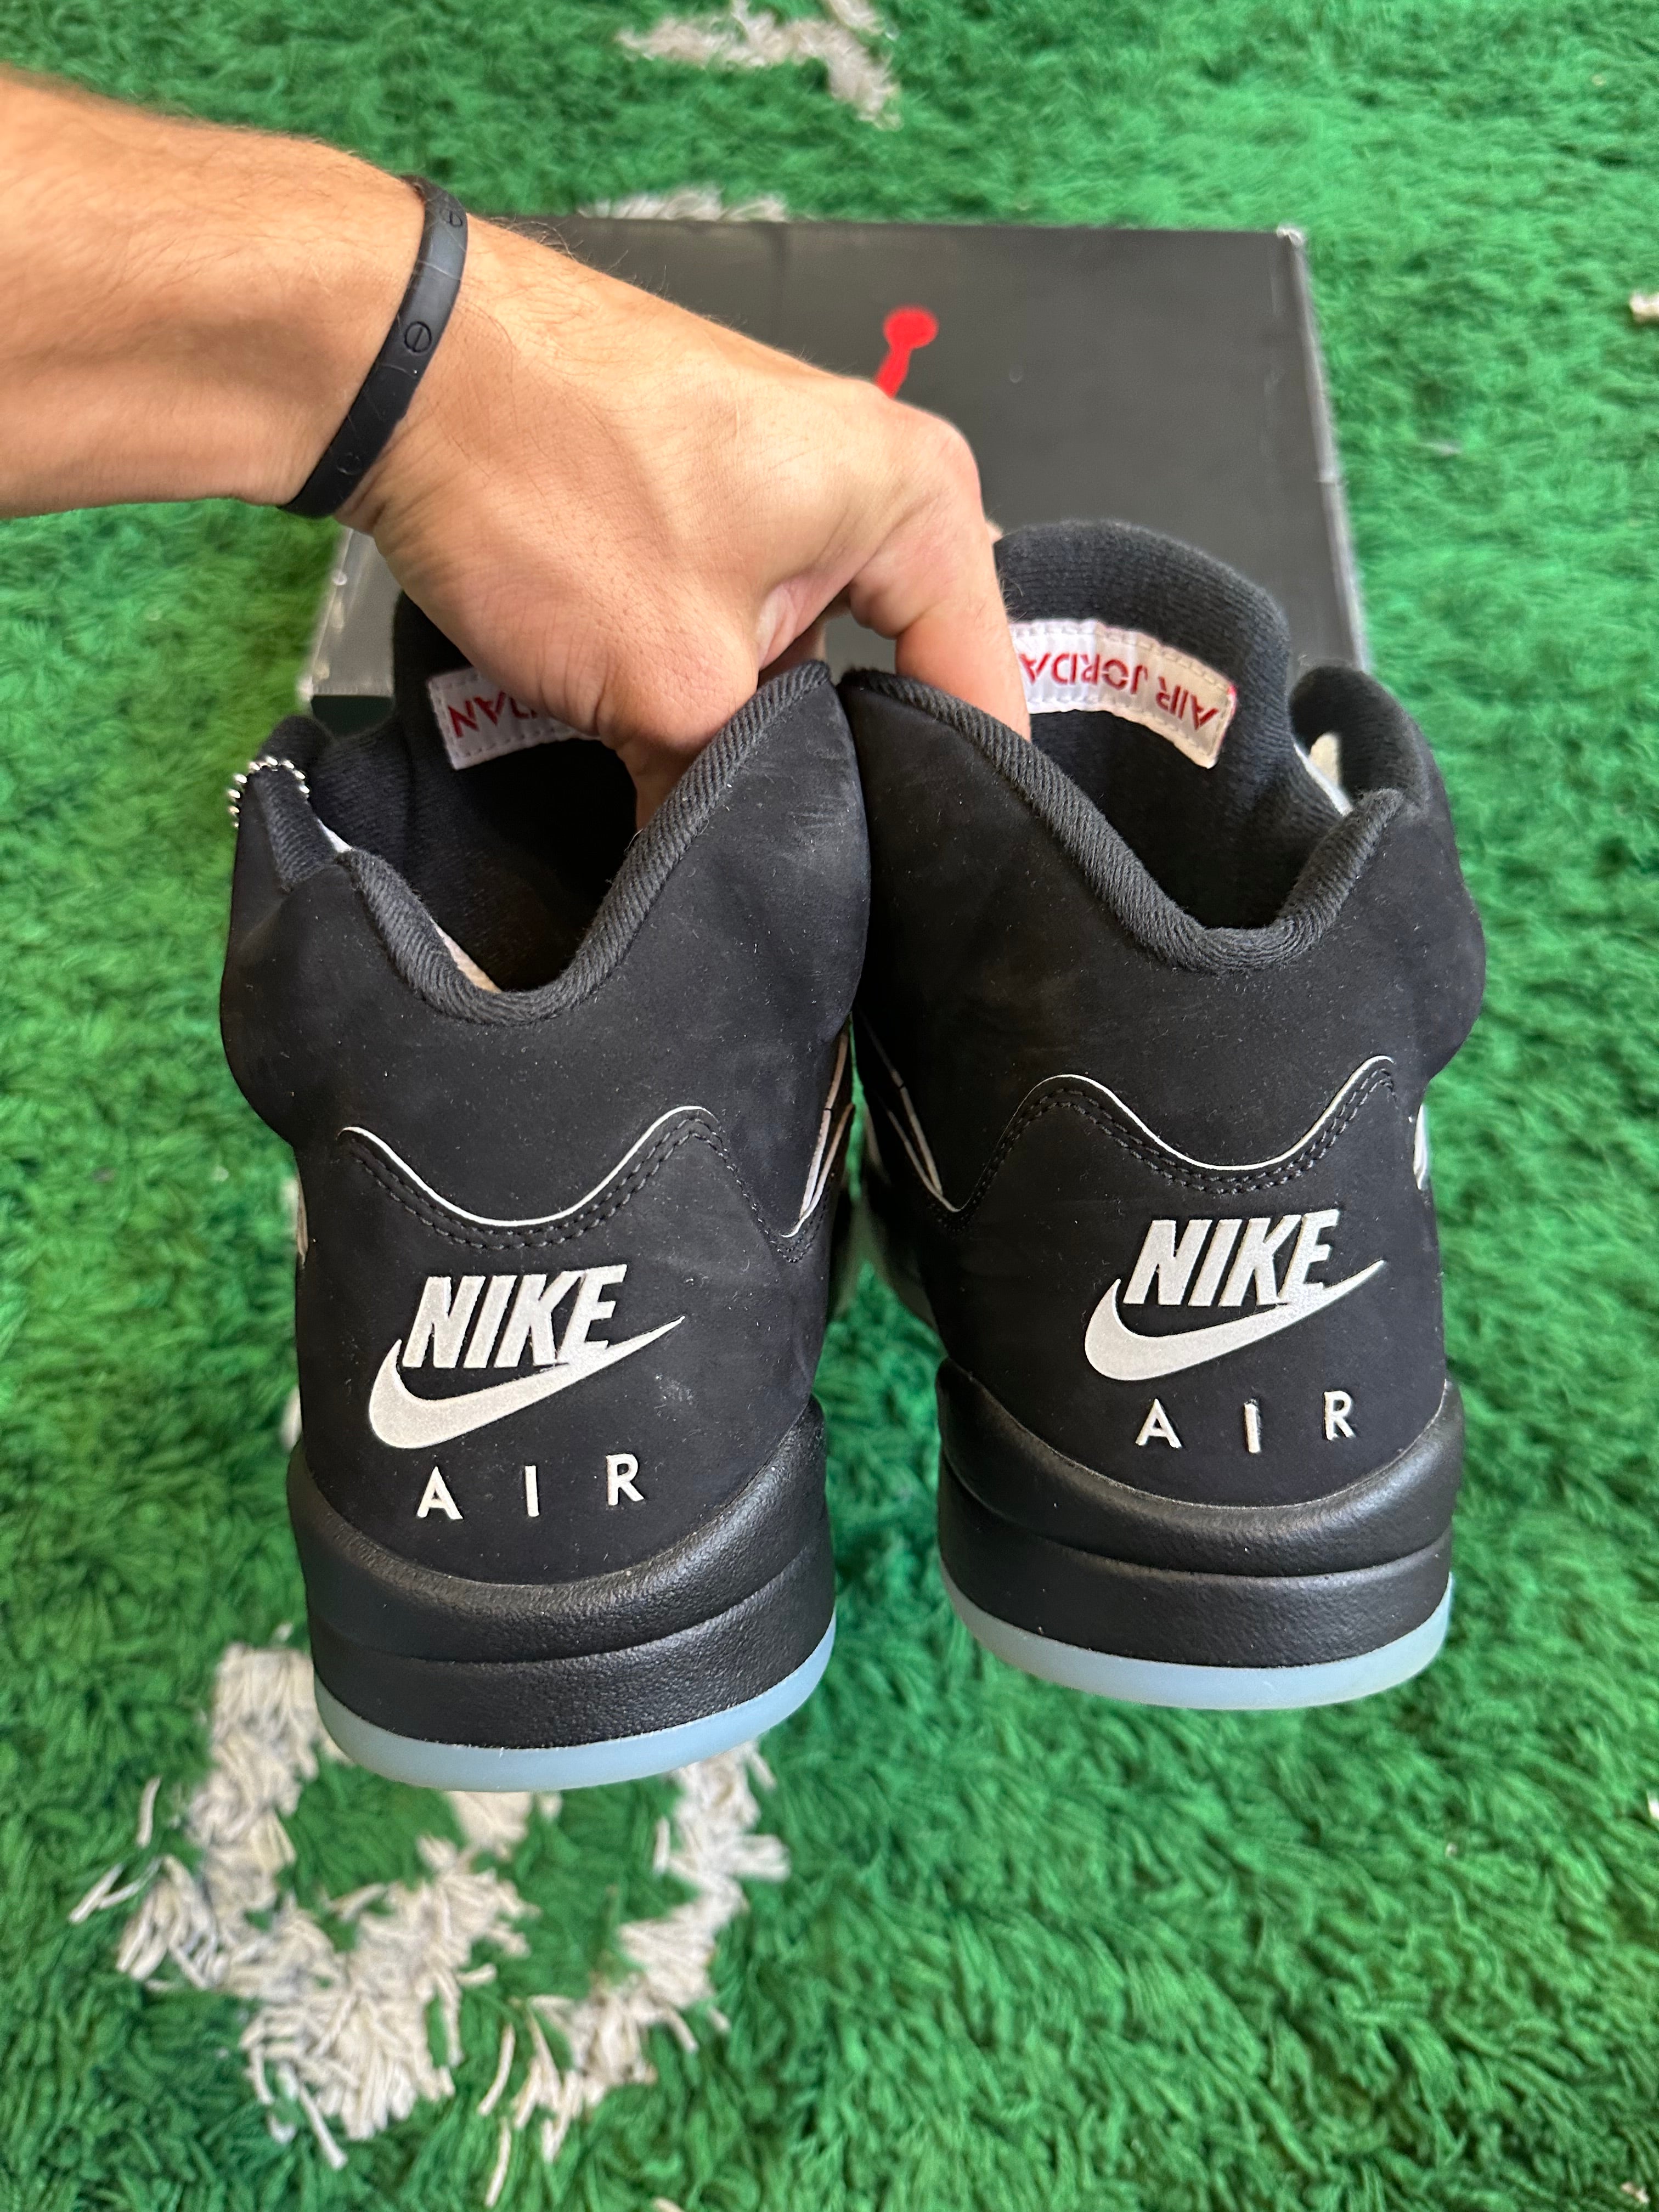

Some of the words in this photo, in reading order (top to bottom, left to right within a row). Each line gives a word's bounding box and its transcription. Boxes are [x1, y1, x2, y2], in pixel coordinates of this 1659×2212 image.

[1018, 651, 1149, 695] JORDA
[1155, 675, 1219, 731] AIR
[1122, 1209, 1340, 1307] NIKE
[402, 1263, 628, 1369] NIKE
[1135, 1390, 1356, 1454] AIR
[416, 1452, 645, 1520] AIR
